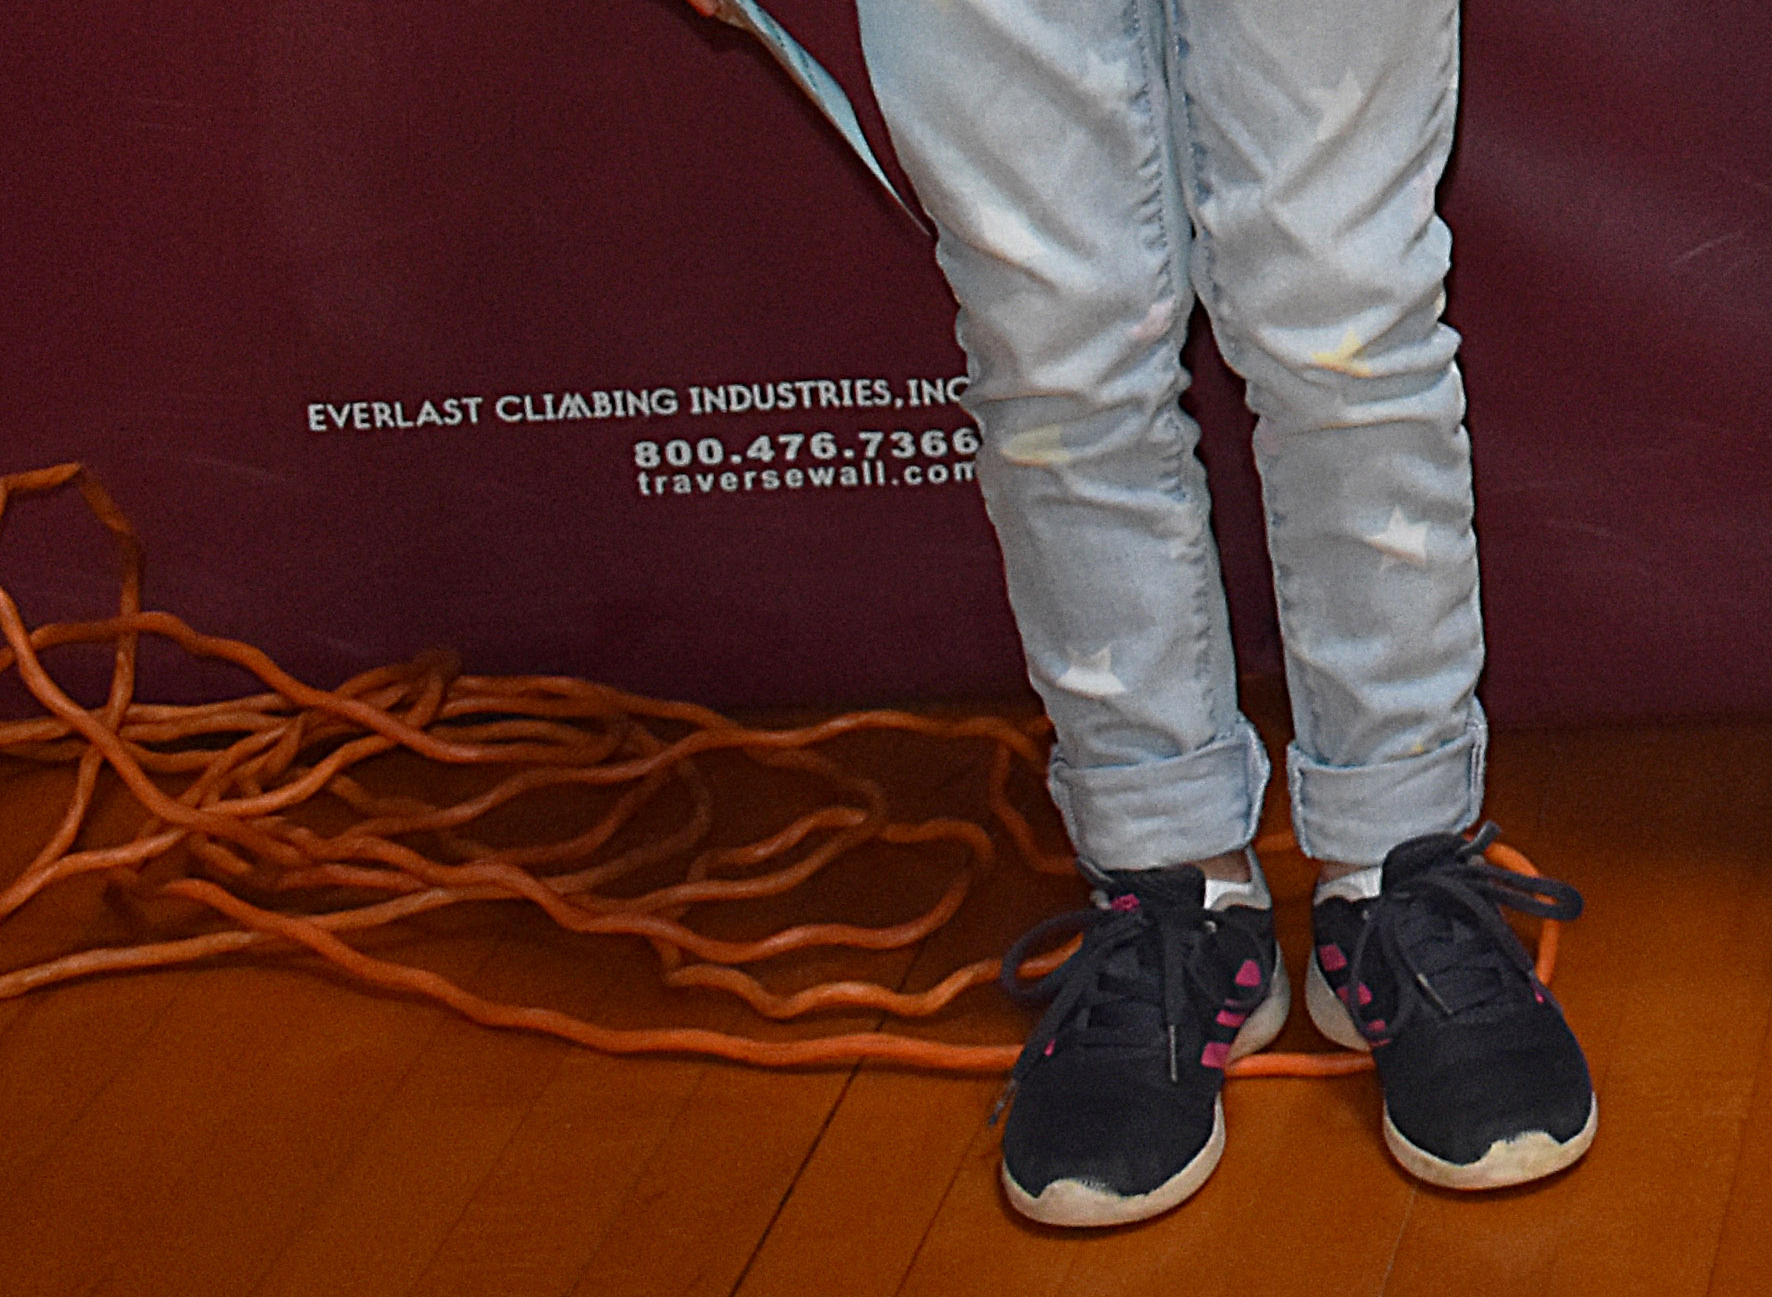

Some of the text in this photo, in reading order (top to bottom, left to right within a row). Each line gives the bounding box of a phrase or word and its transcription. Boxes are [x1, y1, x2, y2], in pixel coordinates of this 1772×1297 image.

[307, 396, 483, 432] EVERLAST
[494, 387, 679, 423] CLIMBING
[633, 427, 980, 468] 800.476.7366
